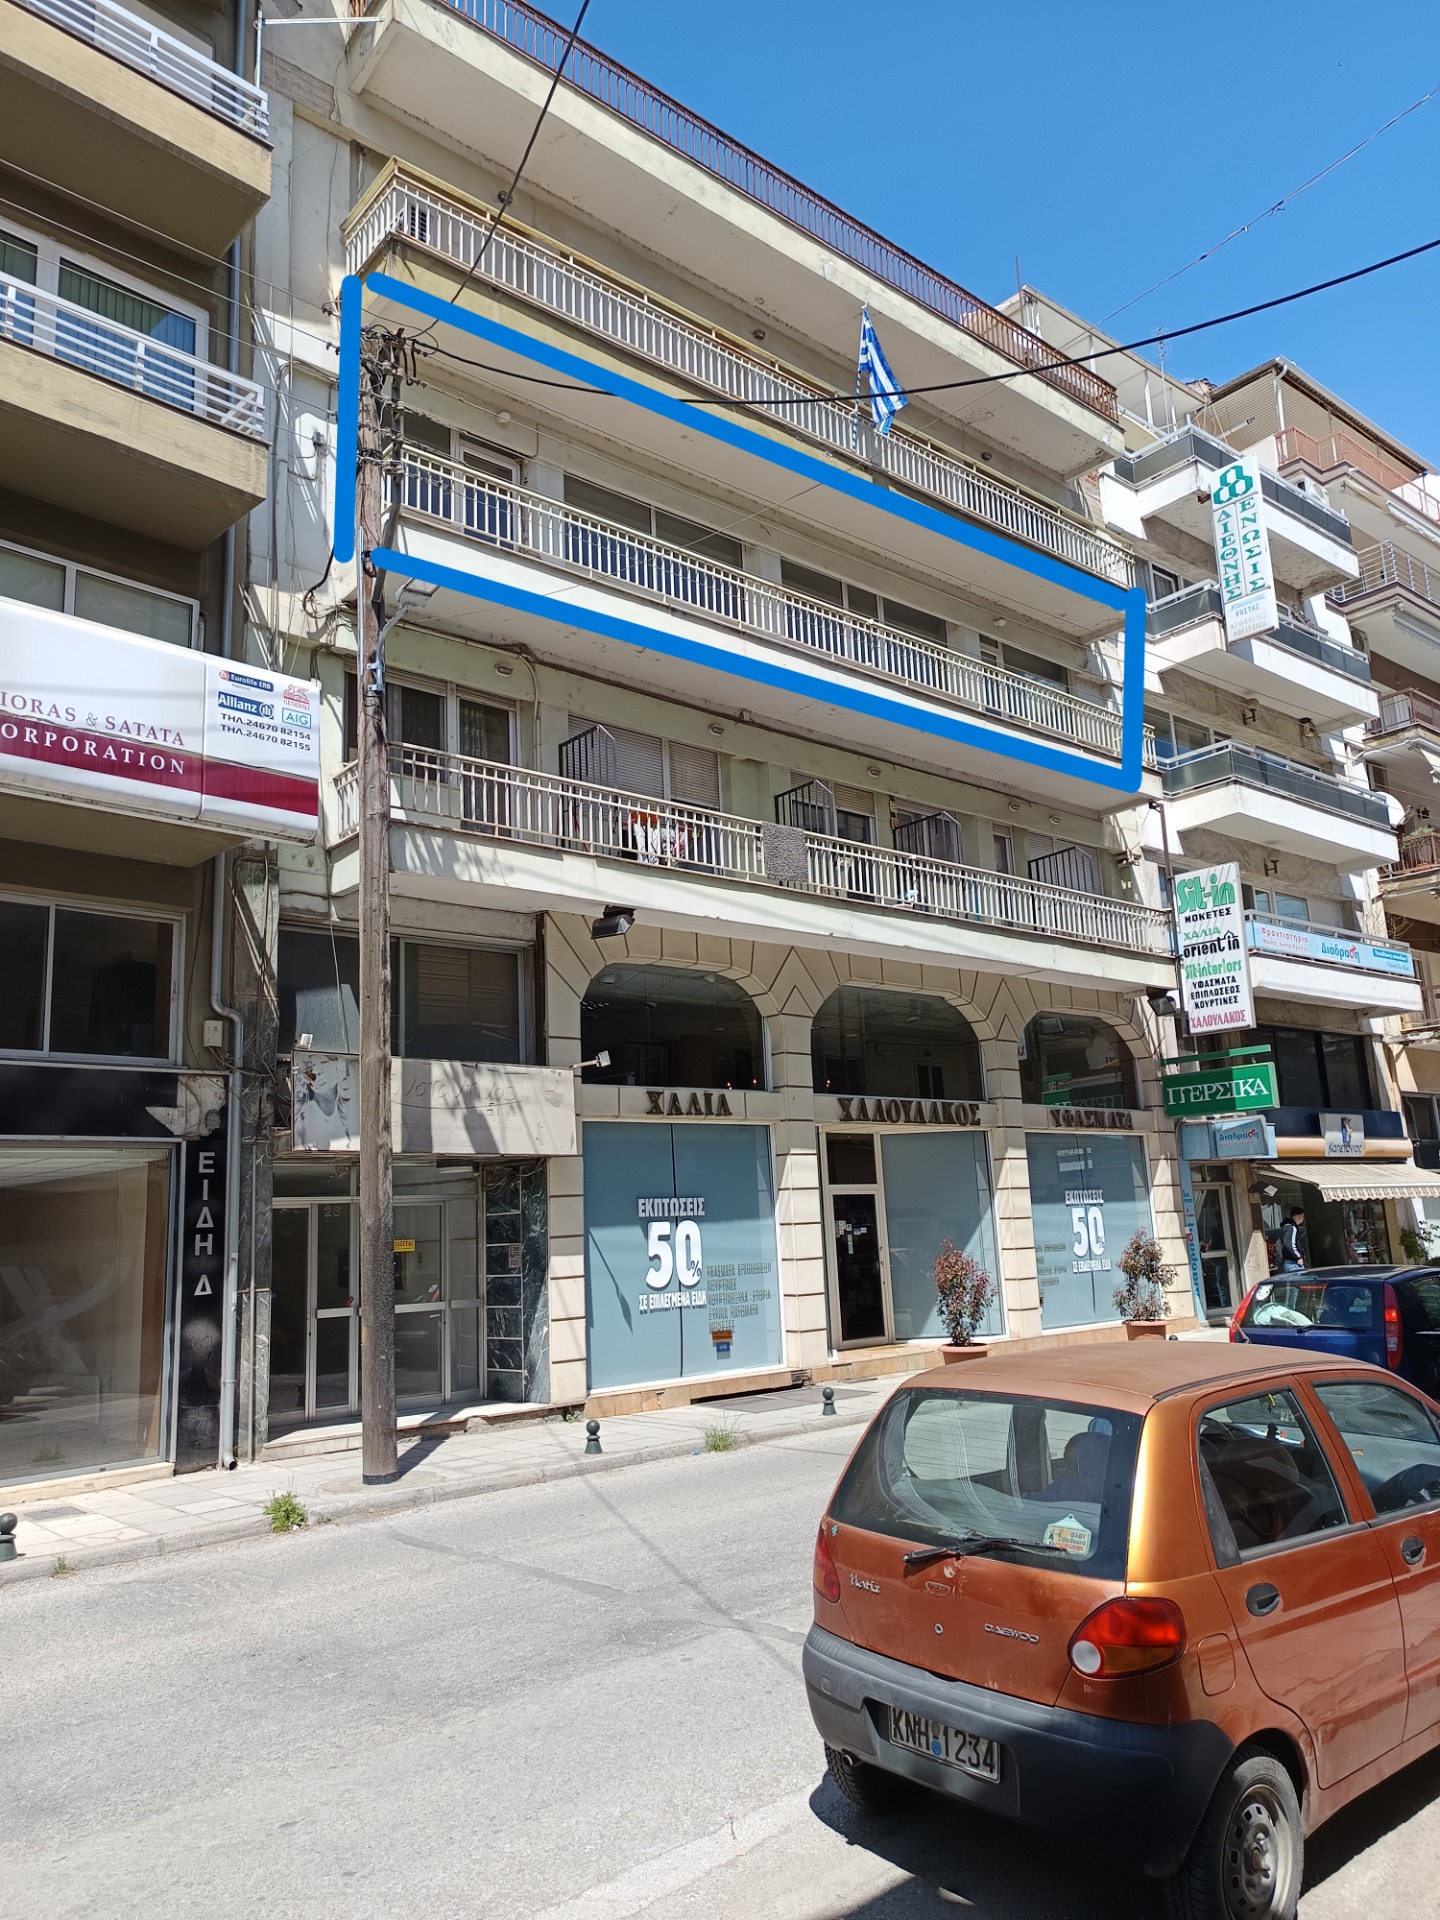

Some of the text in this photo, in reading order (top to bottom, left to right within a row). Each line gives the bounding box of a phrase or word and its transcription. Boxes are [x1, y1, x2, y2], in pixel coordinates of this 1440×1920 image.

[1217, 496, 1266, 601] ΔΙΕΘΝΗΣ ΕΝΩΣΙΣ
[231, 674, 258, 687] Eurolife
[218, 694, 257, 713] Allianz
[285, 712, 309, 726] AIG
[86, 712, 98, 727] &
[105, 716, 186, 746] SATATA
[280, 727, 311, 741] 82154
[280, 738, 311, 752] 82155
[1177, 873, 1236, 914] Sit-in
[1185, 907, 1232, 923] ΜΟΚΕΤΕΣ
[1183, 926, 1221, 941] ΧΑΛΙΑ
[1183, 937, 1226, 958] orient
[1192, 975, 1237, 990] ΥΦΑΣΜΑΤΑ
[1190, 985, 1241, 1000] ΕΠΙΠΛΩΣΕΩΣ
[1194, 995, 1239, 1010] ΚΟΥΡΤΙΝΕΣ
[1190, 1009, 1247, 1029] ΧΑΛΟΥΛΑΚΟΣ
[1166, 1078, 1270, 1105] ΠΕΡΣΙΚΑ
[645, 1091, 733, 1116] ΧΑΛΙΑ
[837, 1097, 981, 1126] ΧΑΛΟΥΛΑΚΟΣ
[1049, 1109, 1134, 1130] ΥΦΑΣΜΑΤΑ
[1064, 1189, 1104, 1205] ΕΚΠΤΩΣΕΙΣ
[638, 1197, 706, 1217] ΕΚΠΤΩΣΕΙΣ
[638, 1294, 648, 1310] ΣΕ
[691, 1289, 707, 1306] ΕΙΔΗ
[1071, 1531, 1087, 1540] BABY
[984, 1622, 1040, 1643] DAEWOO
